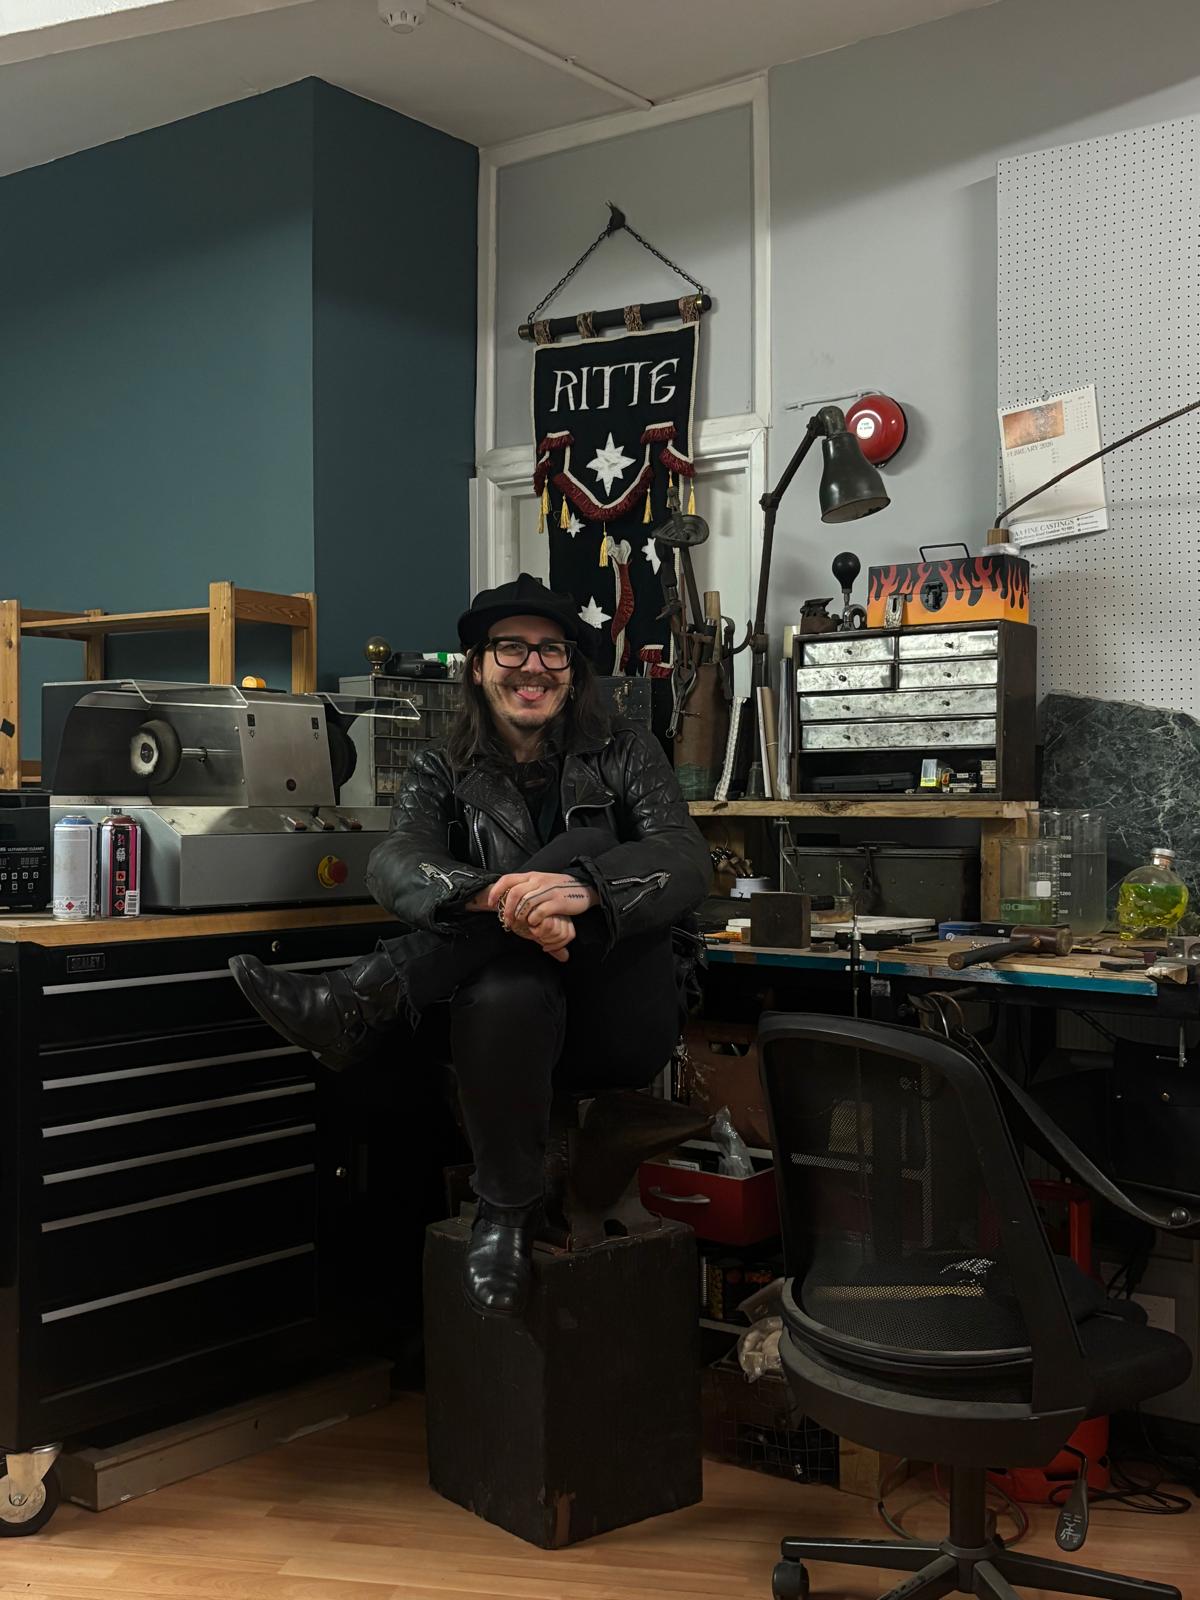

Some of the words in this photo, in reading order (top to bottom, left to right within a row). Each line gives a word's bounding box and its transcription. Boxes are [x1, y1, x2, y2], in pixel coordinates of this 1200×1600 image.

[550, 358, 680, 412] RITTE
[1007, 444, 1038, 457] FEBRUARY
[1024, 526, 1038, 535] FINE
[1040, 519, 1074, 531] CASTINGS
